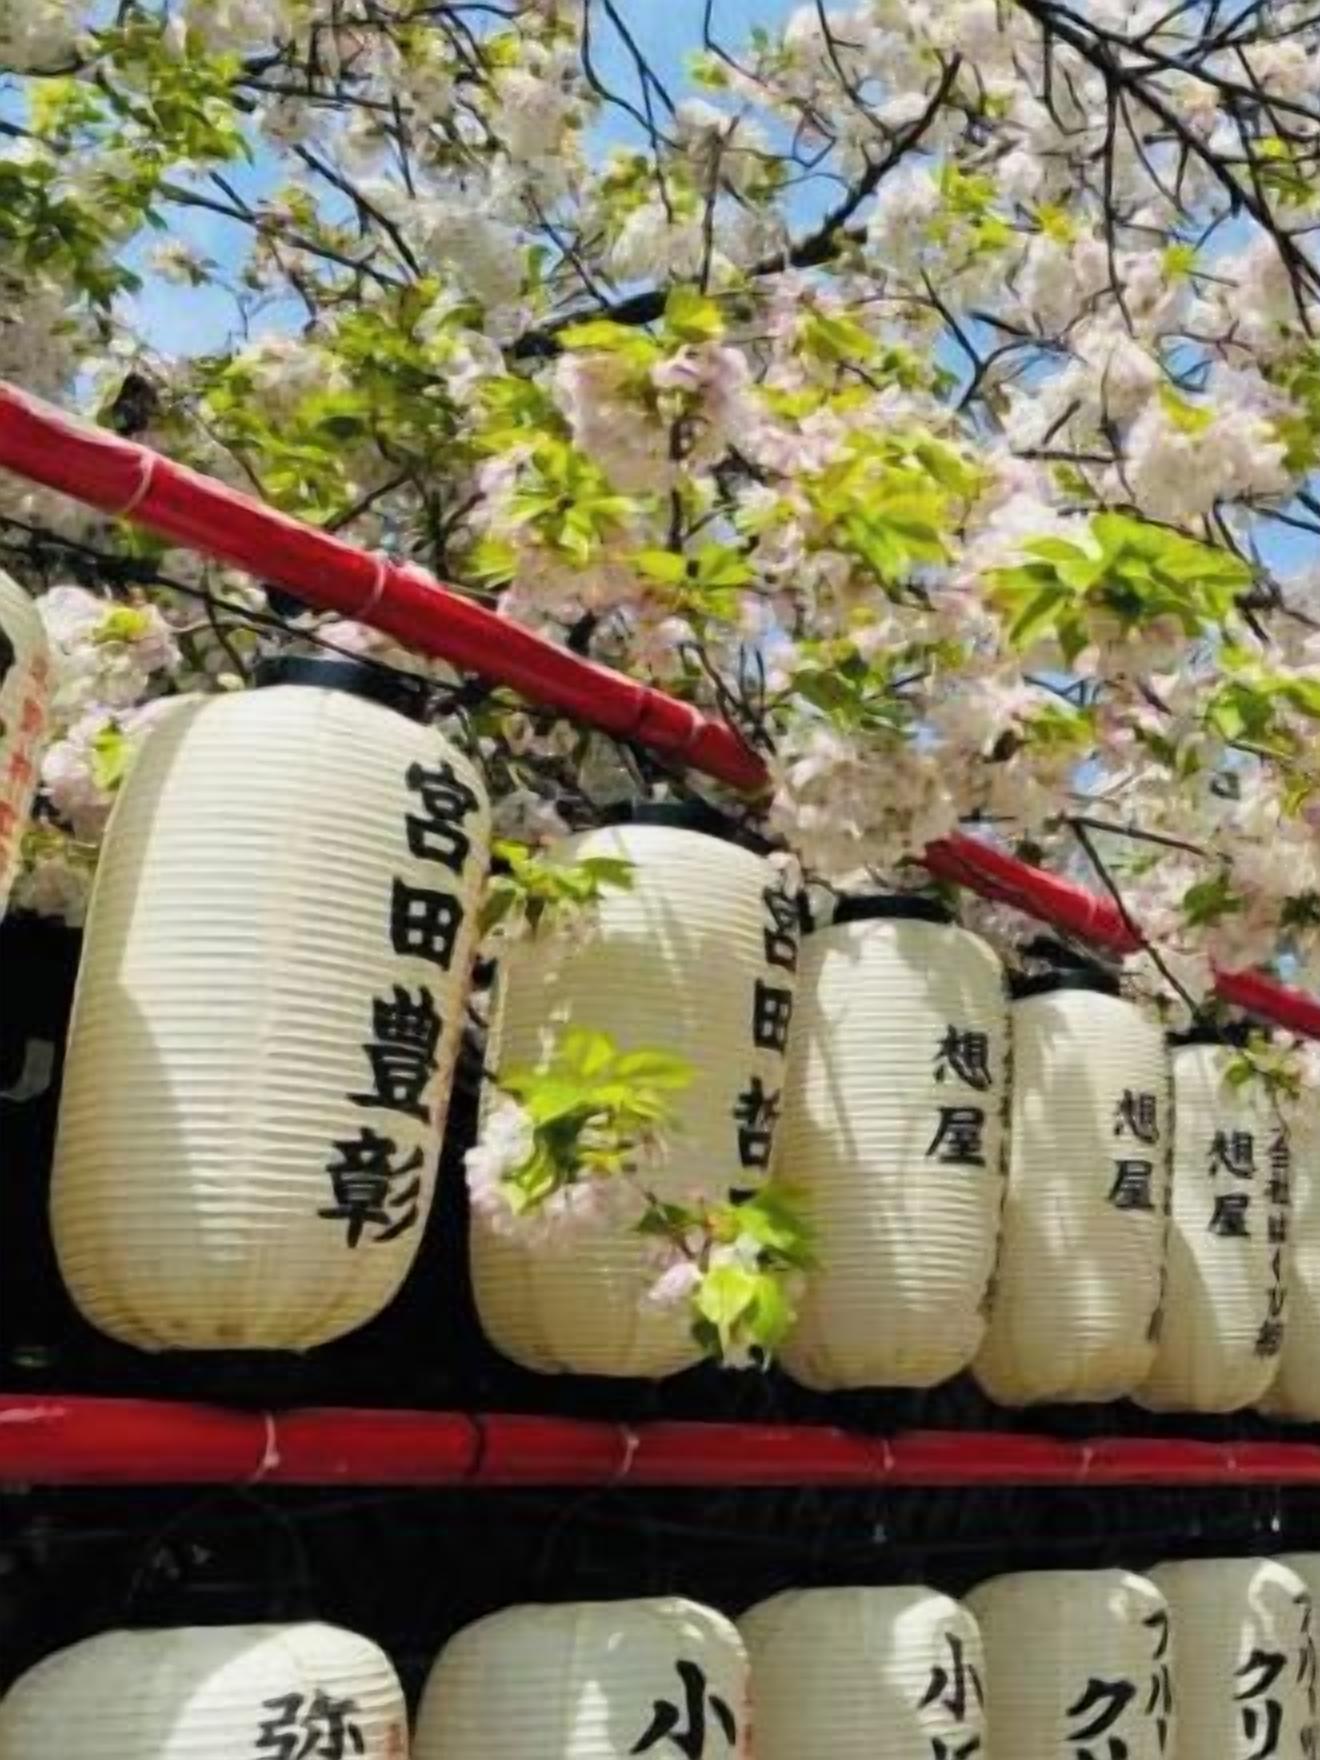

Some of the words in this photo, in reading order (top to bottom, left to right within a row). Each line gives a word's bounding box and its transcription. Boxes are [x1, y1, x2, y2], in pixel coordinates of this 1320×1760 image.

[729, 887, 798, 1203] 宮田哲
[926, 1024, 993, 1166] 想屋
[1106, 1088, 1160, 1210] 想屋
[1208, 1130, 1257, 1237] 想屋
